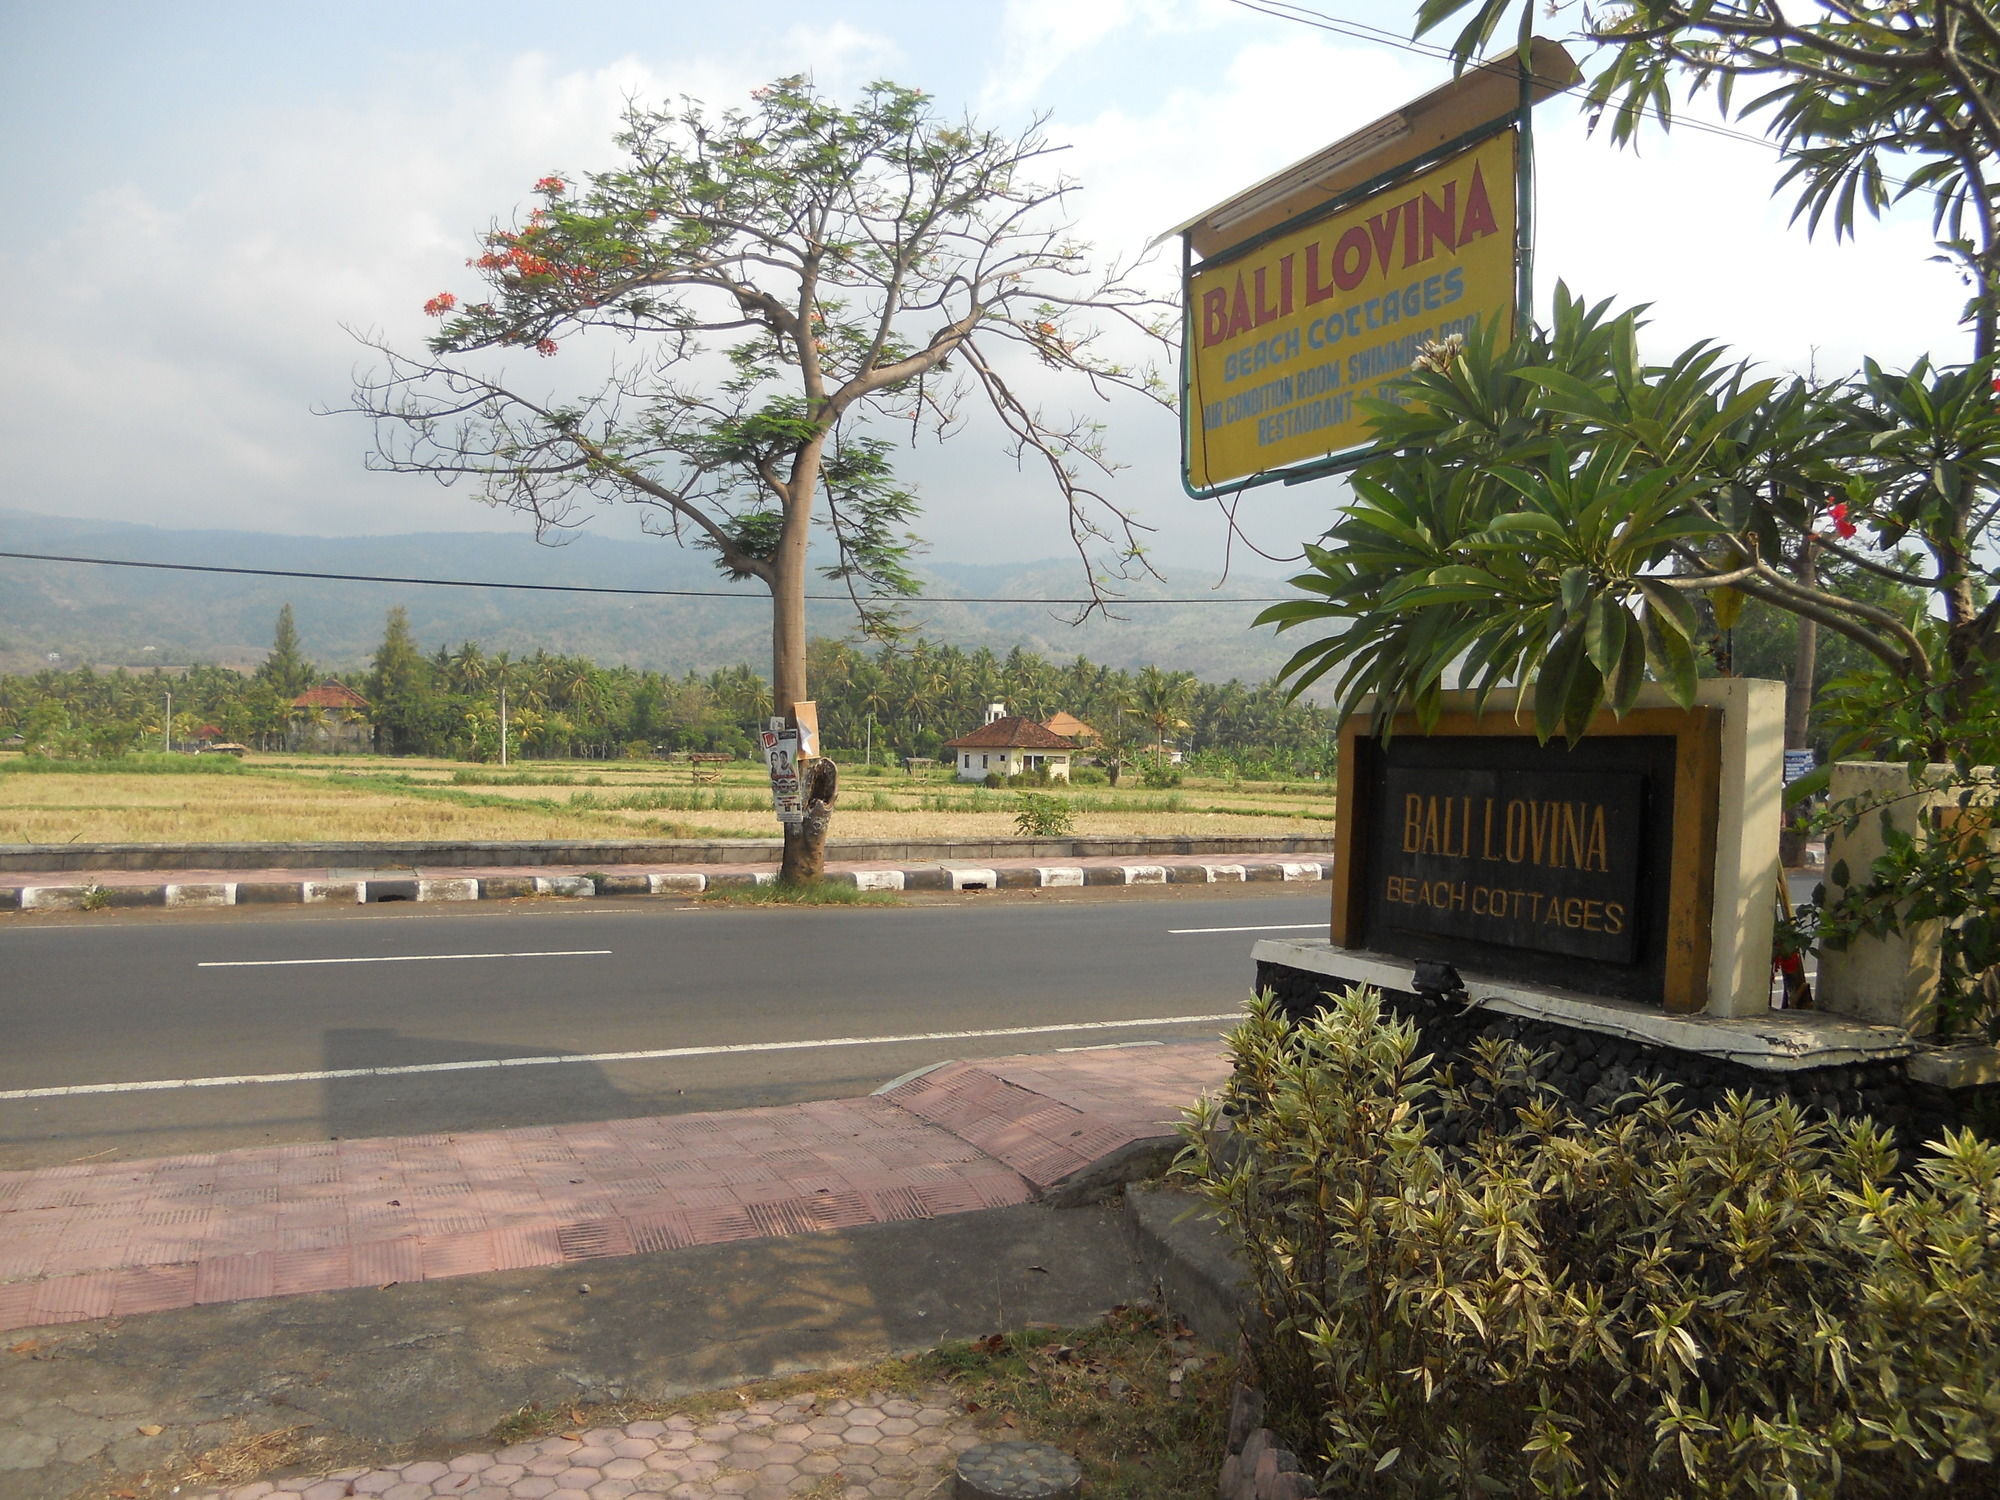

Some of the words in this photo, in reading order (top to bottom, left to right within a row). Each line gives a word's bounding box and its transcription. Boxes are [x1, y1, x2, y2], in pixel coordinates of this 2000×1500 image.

[1202, 253, 1296, 349] BALI
[1304, 157, 1499, 308] LOVINA
[1223, 328, 1300, 383] BEACH
[1307, 266, 1465, 349] COTTAGES
[1226, 375, 1293, 424] CONDITION
[1258, 390, 1354, 447] RESTAURANT
[1402, 793, 1472, 859] BALI
[1481, 797, 1609, 873] LOVINA
[1386, 876, 1466, 912] BEACH
[1472, 887, 1625, 935] COTTAGES
